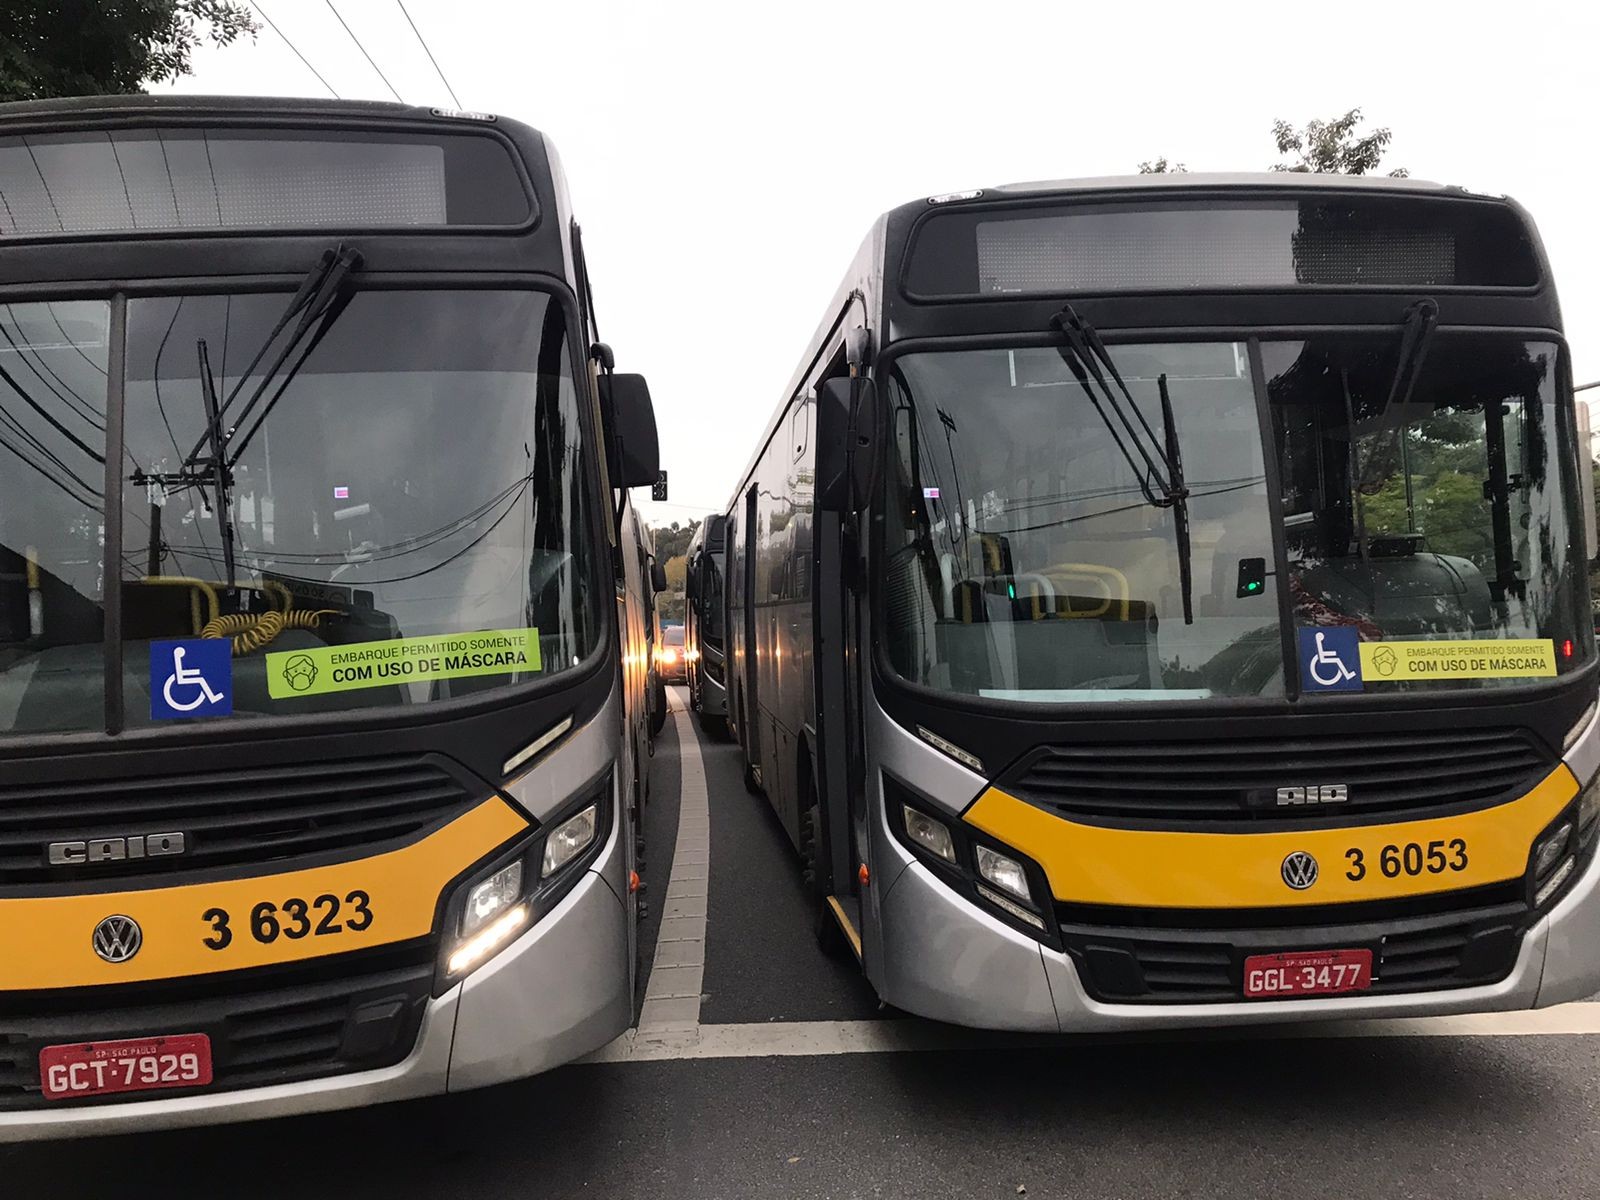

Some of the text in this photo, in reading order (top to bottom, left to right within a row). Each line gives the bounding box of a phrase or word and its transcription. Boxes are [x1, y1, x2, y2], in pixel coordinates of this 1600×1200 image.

[331, 636, 526, 664] EMBARQUE PERMITIDO SOMENTE
[332, 650, 527, 683] COM USO DE MÁSCARA
[1406, 645, 1545, 657] EMBARQUE PERMITIDO SOMENTE
[1408, 657, 1547, 672] COM USO DE MÁSCARA
[49, 831, 185, 865] CAIO
[1344, 838, 1468, 882] 3 6053
[202, 890, 374, 950] 3 6323
